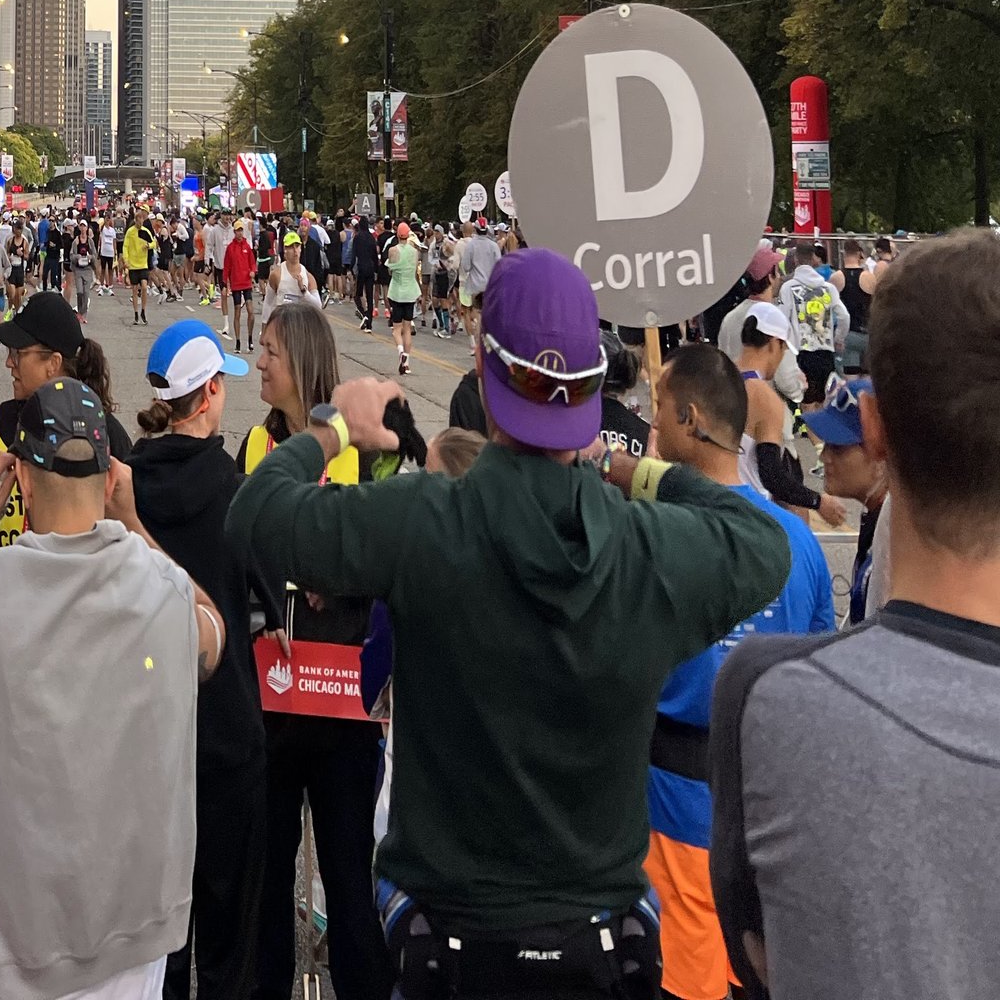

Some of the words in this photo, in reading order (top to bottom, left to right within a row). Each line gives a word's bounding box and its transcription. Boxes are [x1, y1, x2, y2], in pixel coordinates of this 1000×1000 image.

[584, 50, 704, 221] D
[246, 190, 256, 207] C
[362, 196, 370, 208] A
[573, 233, 714, 291] Corral
[299, 666, 321, 675] BANK
[324, 668, 334, 676] OF
[335, 669, 359, 679] AMER
[298, 679, 341, 694] CHICAGO
